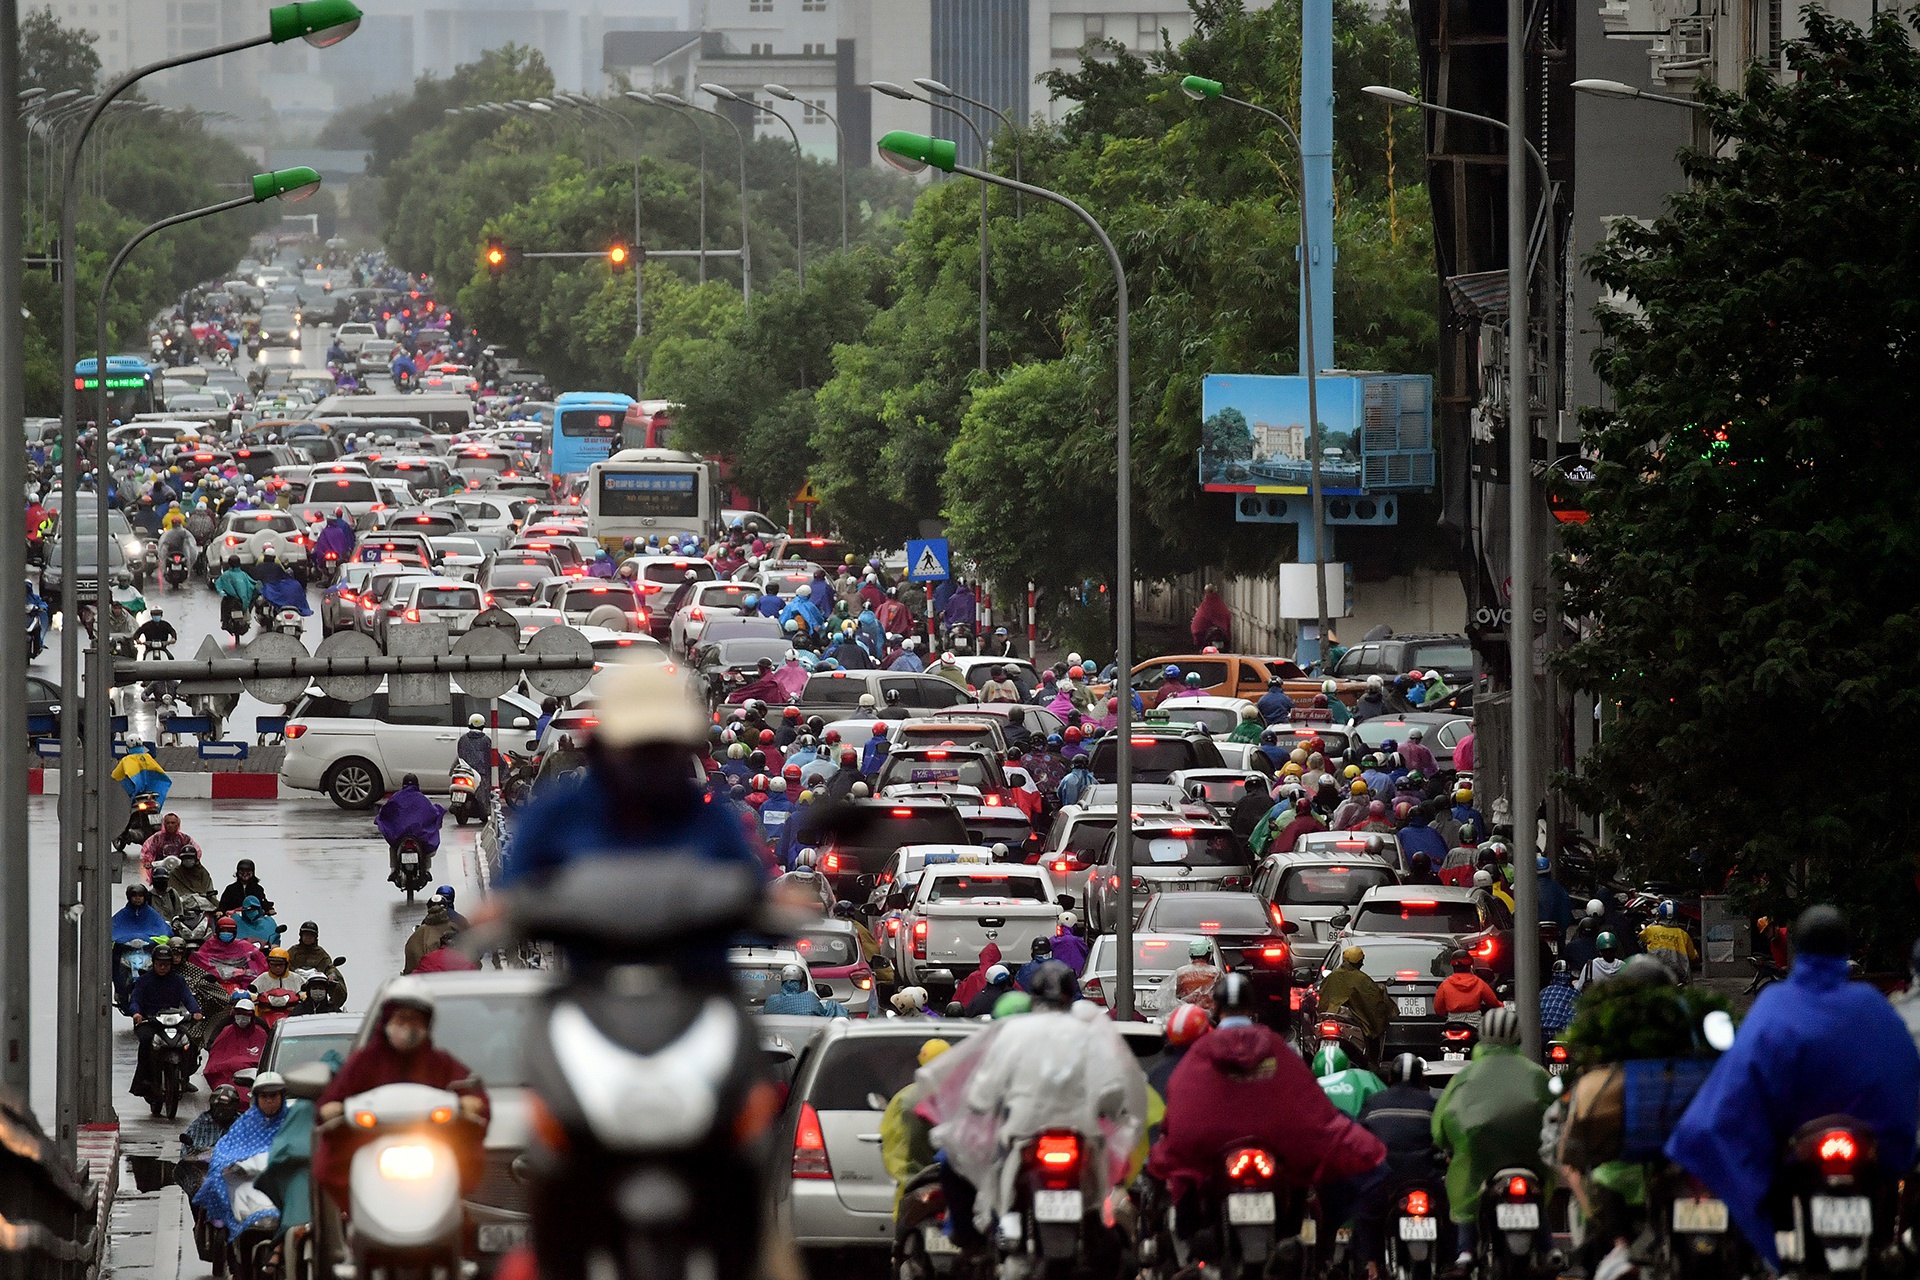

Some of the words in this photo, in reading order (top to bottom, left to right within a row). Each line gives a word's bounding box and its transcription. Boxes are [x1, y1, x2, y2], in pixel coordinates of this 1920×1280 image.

[1564, 471, 1579, 480] Mai
[1404, 997, 1419, 1007] 30E
[1399, 1006, 1426, 1016] 104.89
[1324, 1081, 1354, 1094] rab
